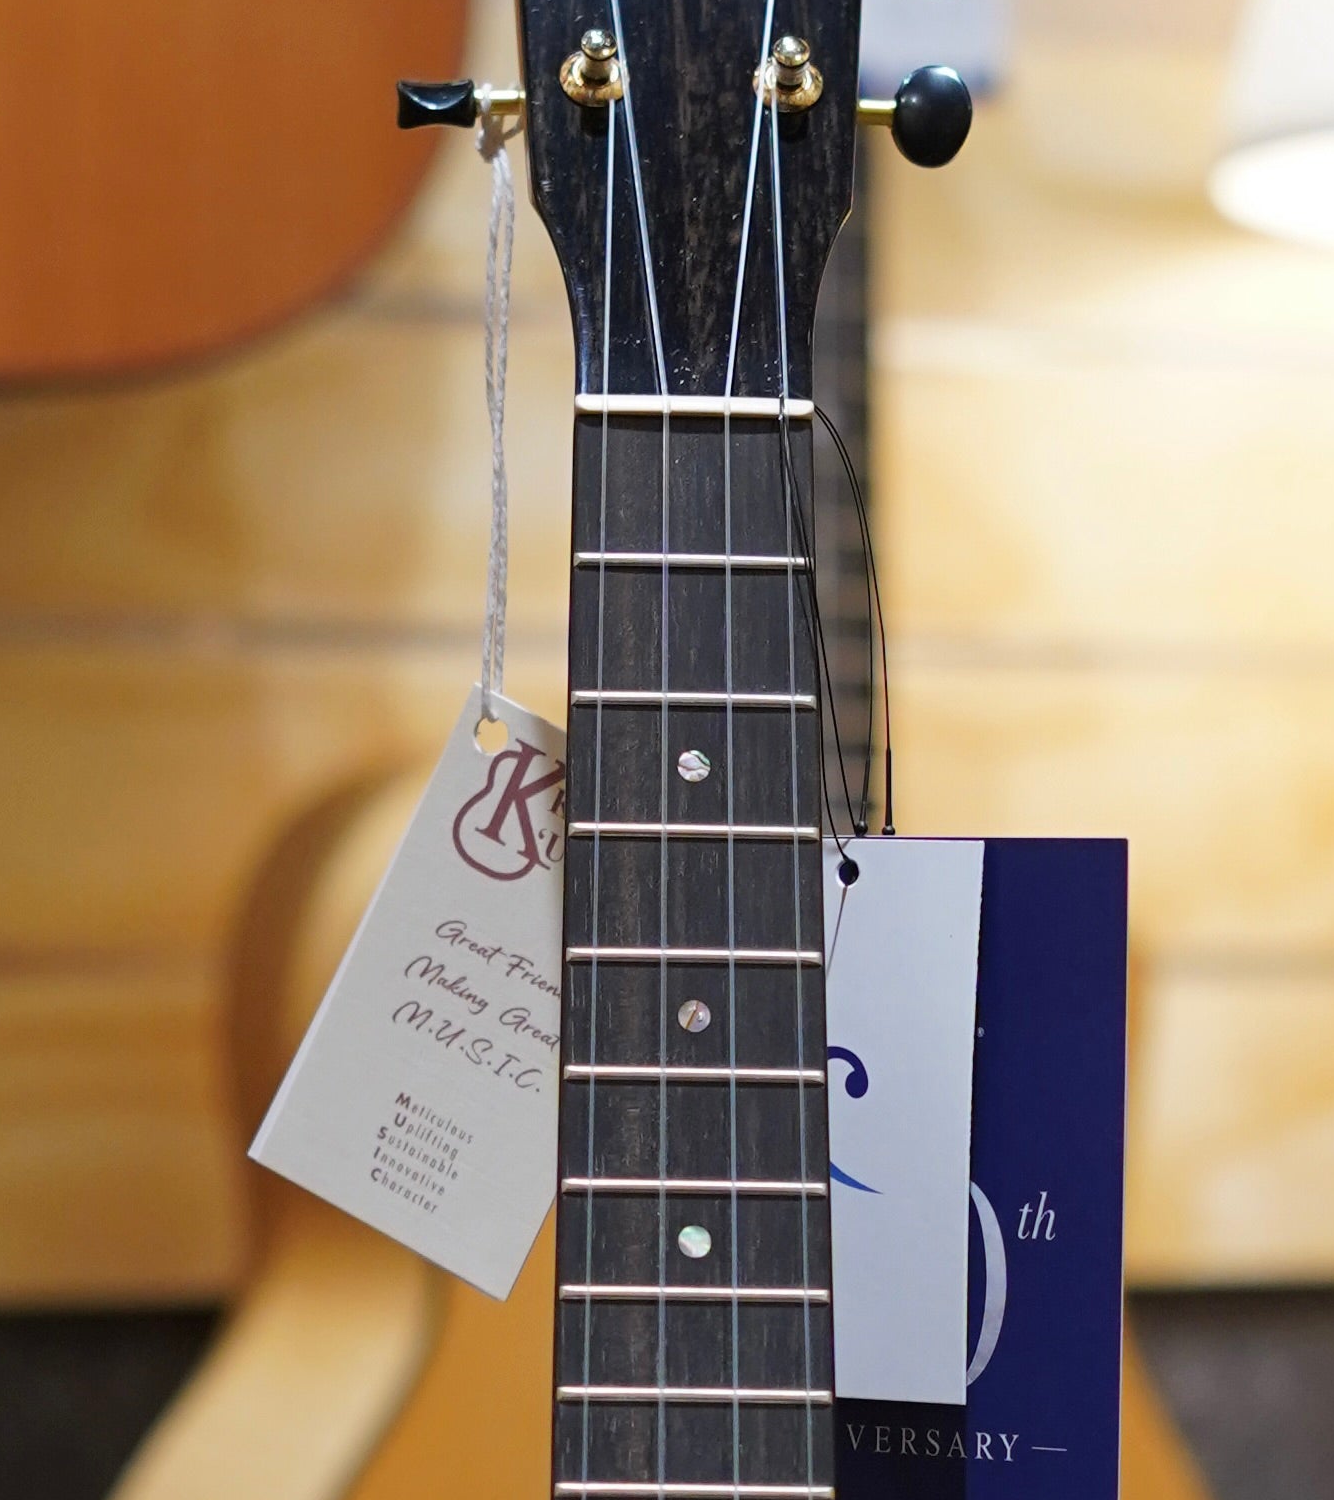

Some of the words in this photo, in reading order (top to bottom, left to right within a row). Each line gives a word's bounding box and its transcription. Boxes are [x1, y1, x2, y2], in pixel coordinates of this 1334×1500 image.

[436, 920, 507, 964] Great
[506, 954, 561, 998] Frien
[405, 956, 489, 1015] Making
[394, 1113, 458, 1161] Uplifting
[395, 1092, 473, 1144] Meticulous
[373, 1146, 445, 1196] Innovative
[377, 1126, 458, 1180] Sustainable
[370, 1167, 438, 1213] Character
[846, 1423, 1019, 1462] VERSARY
